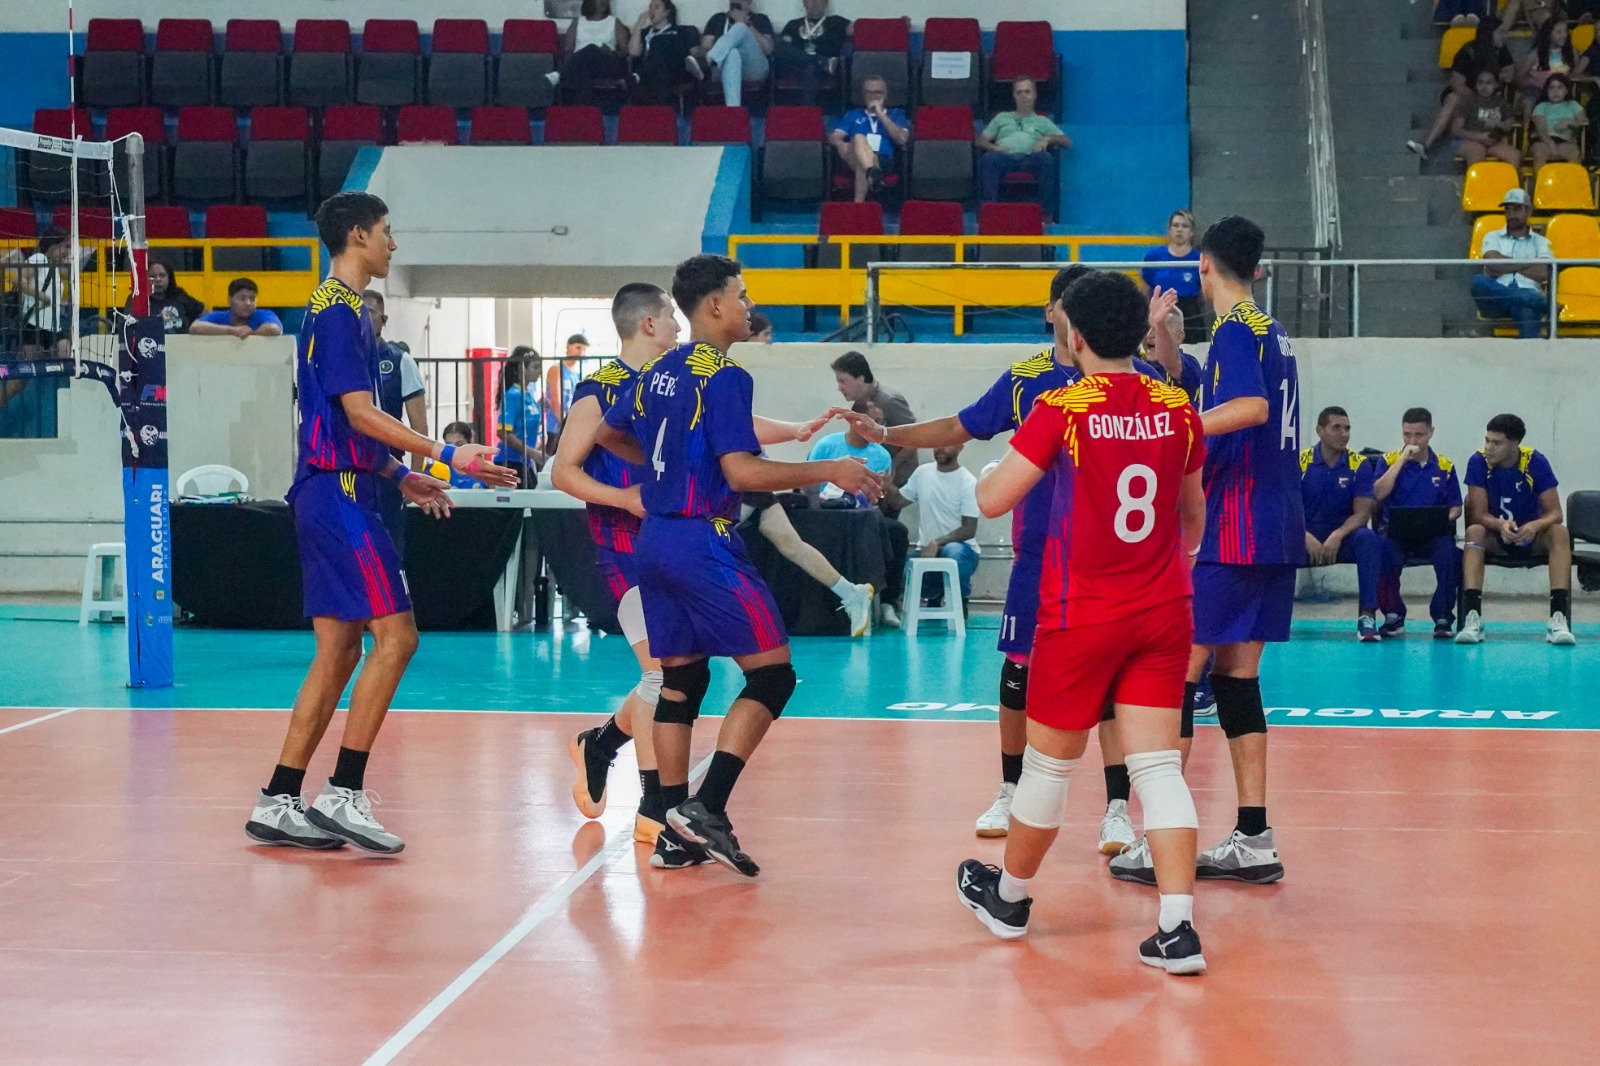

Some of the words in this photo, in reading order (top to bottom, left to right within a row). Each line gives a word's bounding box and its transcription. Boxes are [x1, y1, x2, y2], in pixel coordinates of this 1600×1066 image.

[1088, 411, 1176, 441] GONZÁLEZ
[1278, 378, 1297, 451] 14
[652, 417, 667, 482] 4
[151, 484, 165, 584] ARAGUARI
[1113, 463, 1158, 544] 8
[1498, 494, 1514, 521] 5
[1001, 615, 1017, 641] 11
